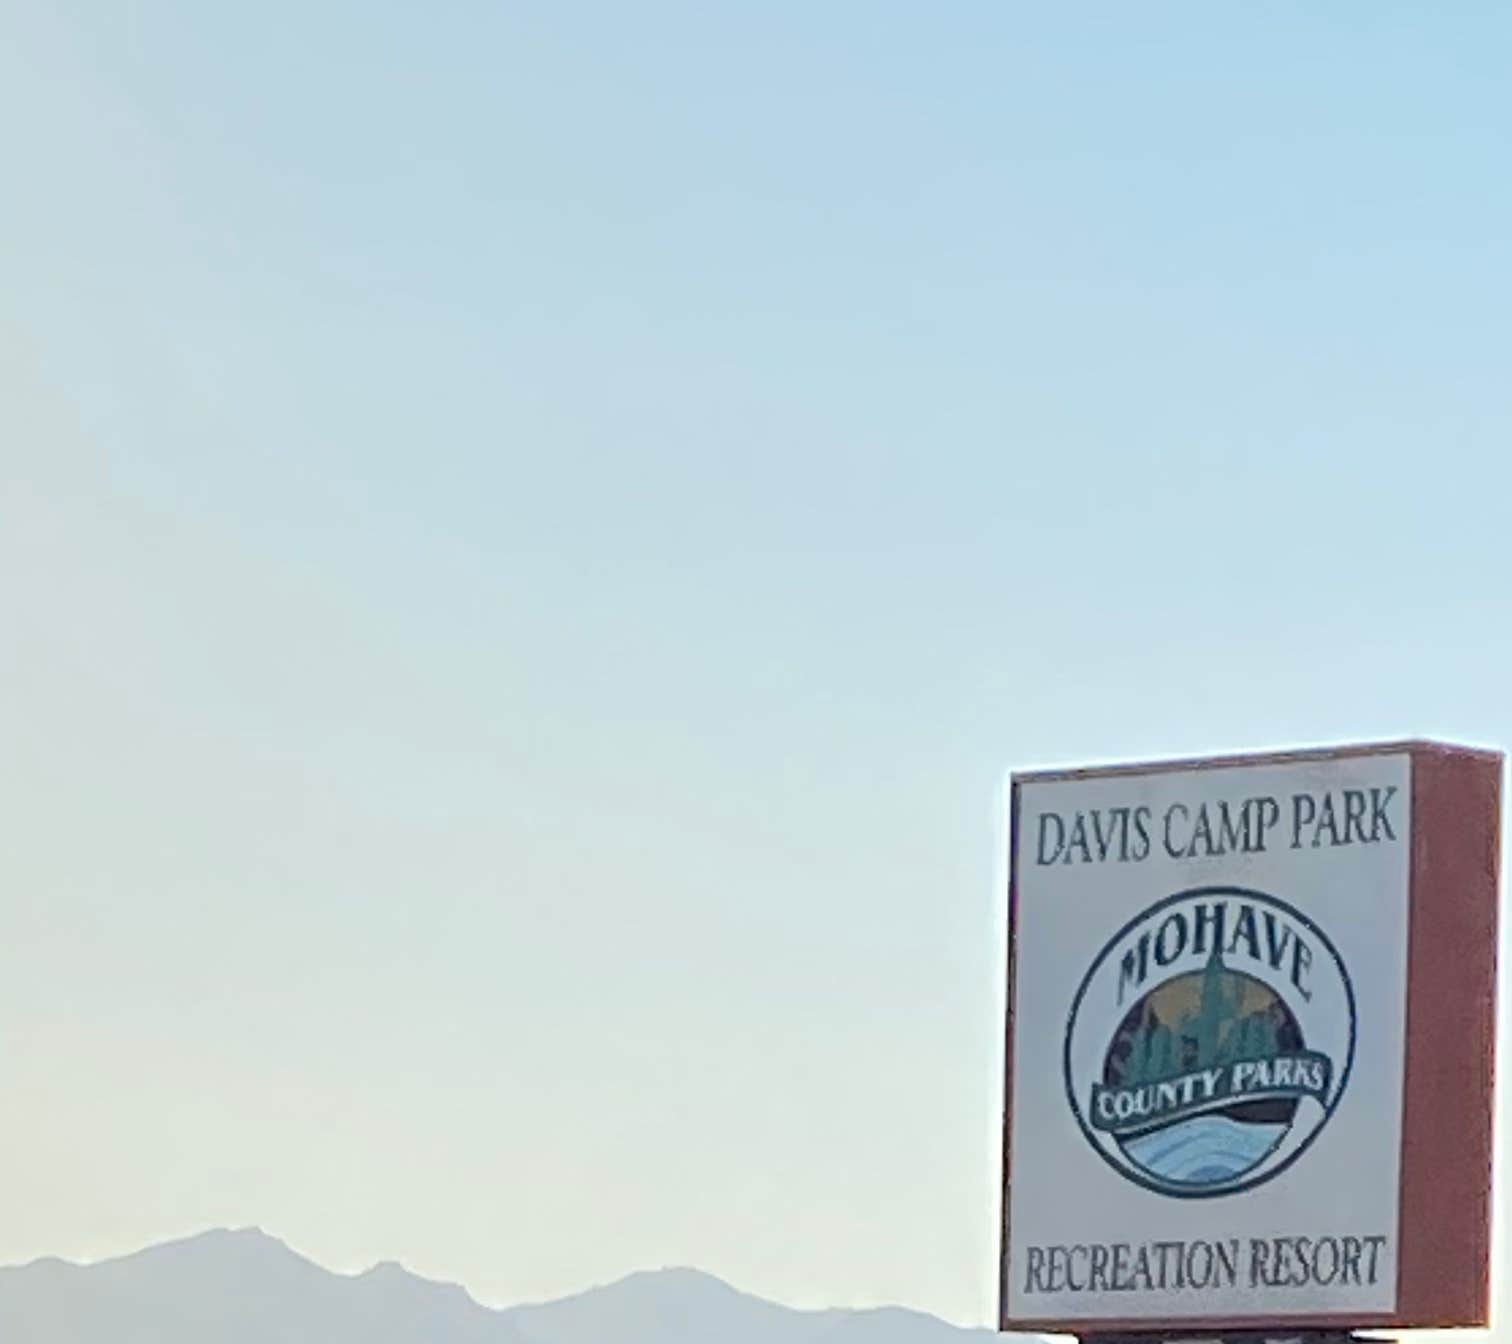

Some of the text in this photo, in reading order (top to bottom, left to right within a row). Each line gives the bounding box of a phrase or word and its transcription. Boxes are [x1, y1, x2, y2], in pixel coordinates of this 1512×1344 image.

[1037, 786, 1398, 865] DAVIS CAMP PARK
[1117, 902, 1313, 1006] MOHAVE
[1100, 1057, 1323, 1119] COUNTY PARKS
[1024, 1235, 1385, 1293] RECREATION RESORT
